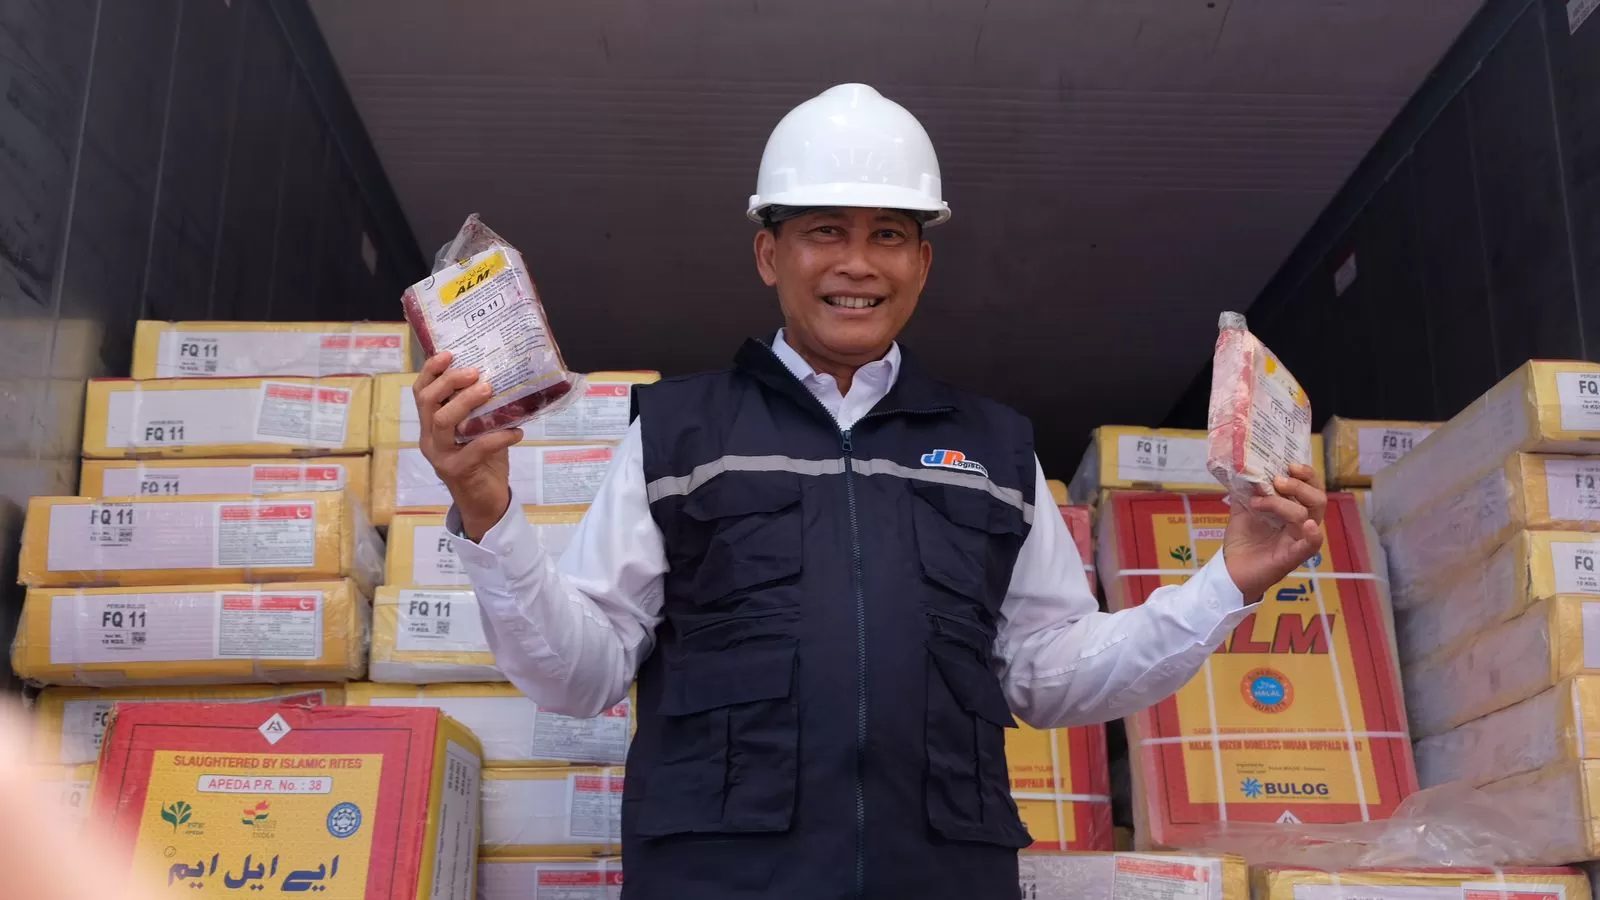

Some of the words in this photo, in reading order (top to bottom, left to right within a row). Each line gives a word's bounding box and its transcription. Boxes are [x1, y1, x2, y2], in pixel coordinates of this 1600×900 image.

[456, 269, 491, 298] ALM
[470, 308, 486, 322] FQ
[488, 300, 498, 310] 11
[180, 343, 199, 357] FQ
[203, 343, 218, 357] 11
[1579, 380, 1599, 395] FQ
[145, 427, 164, 441] FQ
[169, 426, 184, 441] 11
[1137, 440, 1152, 453] FQ
[1156, 443, 1168, 455] 11
[1383, 435, 1398, 448] FQ
[1401, 437, 1413, 449] 11
[141, 481, 159, 494] FQ
[164, 480, 179, 495] 11
[1576, 473, 1595, 489] FQ
[90, 509, 111, 525] FQ
[116, 508, 133, 525] 11
[1575, 555, 1594, 572] FQ
[409, 600, 429, 617] FQ
[434, 600, 450, 617] 11
[102, 611, 123, 628] FQ
[128, 611, 146, 628] 11
[1213, 613, 1335, 655] LM
[1254, 690, 1281, 698] HALAL
[173, 755, 259, 769] SLAUGHTERED
[262, 759, 278, 769] BY
[280, 758, 326, 769] ISLAMIC
[329, 758, 364, 769] RITES
[208, 778, 250, 790] APEDA
[278, 779, 298, 792] No.
[309, 779, 322, 791] 38
[1264, 782, 1329, 796] BULOG
